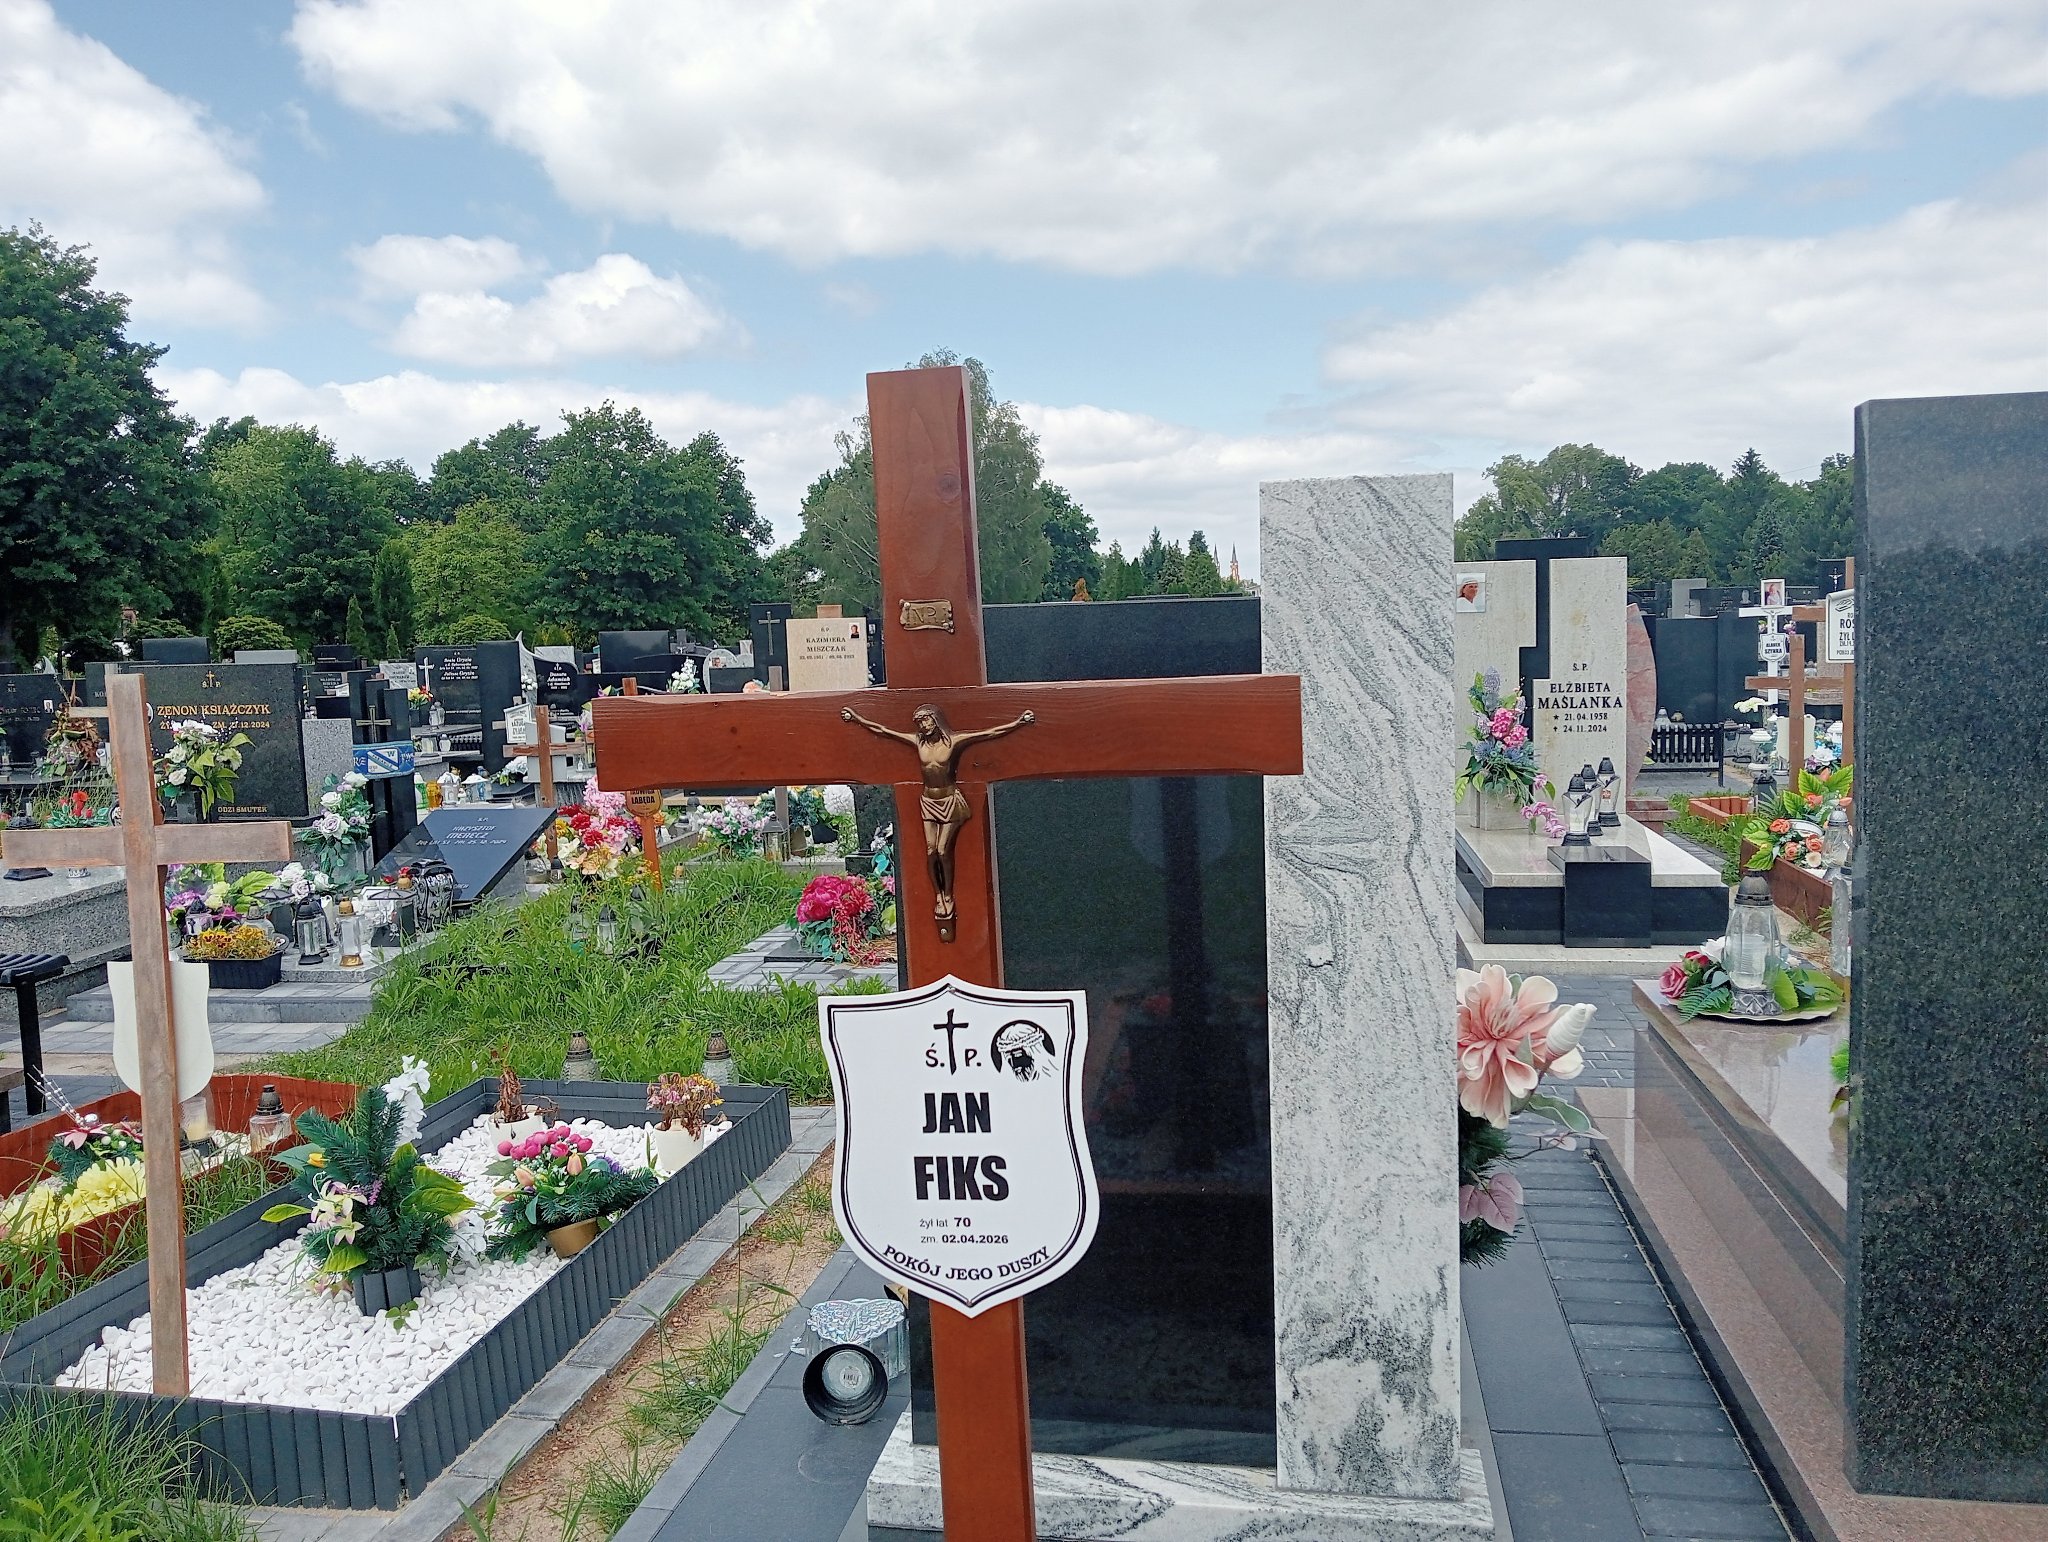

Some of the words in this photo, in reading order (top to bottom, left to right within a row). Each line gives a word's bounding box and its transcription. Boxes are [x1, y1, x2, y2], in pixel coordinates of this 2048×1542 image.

[1550, 681, 1611, 694] ELŻBIETA
[1537, 695, 1623, 710] MAŚLANKA
[157, 705, 198, 716] ZENON
[201, 703, 271, 717] KSIĄŻCZYK
[1564, 712, 1608, 721] 21.04.1958
[1563, 724, 1607, 733] 24.11.2024
[926, 1043, 945, 1068] Ś.
[964, 1049, 982, 1067] P.
[922, 1092, 991, 1133] JAN
[914, 1155, 1010, 1201] FIKS
[919, 1218, 933, 1229] żył
[936, 1218, 948, 1227] lat
[953, 1217, 971, 1228] 70
[941, 1234, 1009, 1244] 02.04.2026
[883, 1244, 941, 1277] POKÓJ
[945, 1267, 993, 1280] JEGO
[997, 1246, 1050, 1278] DUSZY
